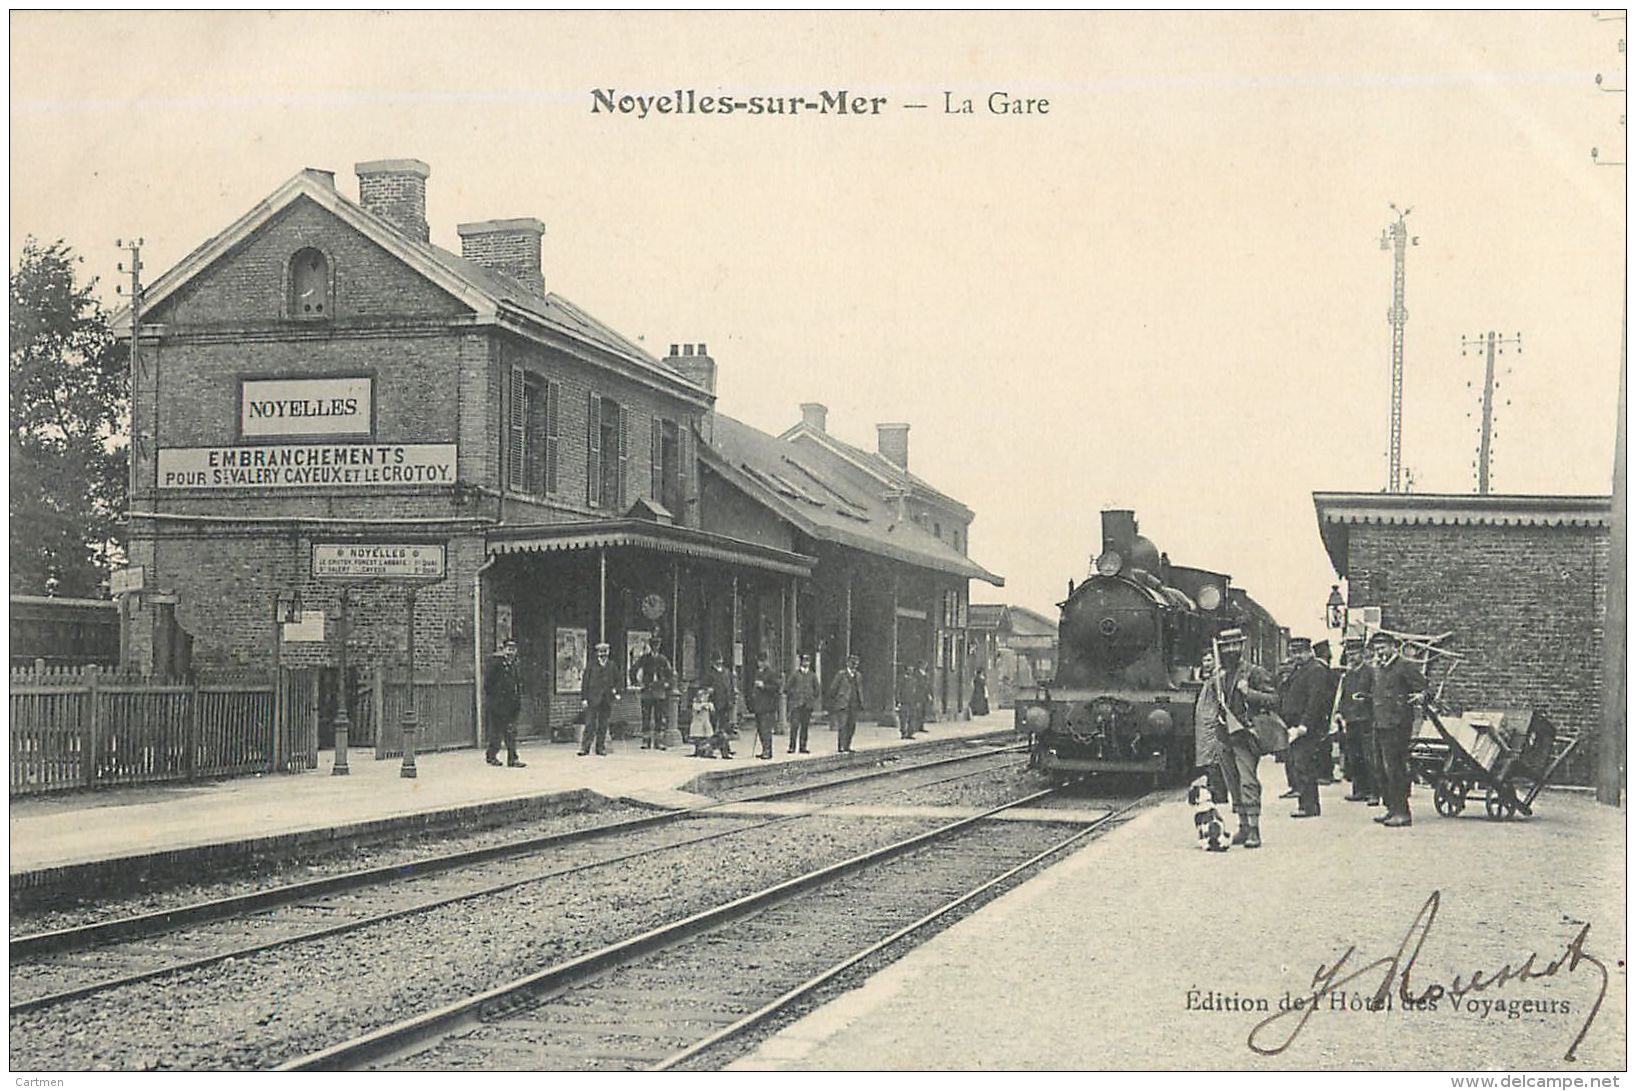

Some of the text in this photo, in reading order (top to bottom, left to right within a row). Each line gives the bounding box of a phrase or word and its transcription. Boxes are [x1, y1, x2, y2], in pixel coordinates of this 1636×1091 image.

[209, 447, 404, 467] EMBRANCHEMENTS
[166, 471, 206, 485] POUR
[229, 467, 281, 485] VALERY
[284, 466, 342, 483] CAYEUX
[344, 469, 361, 483] ET
[364, 468, 379, 482] LE
[382, 464, 452, 482] CROTOY.
[350, 549, 406, 558] NOYELLES
